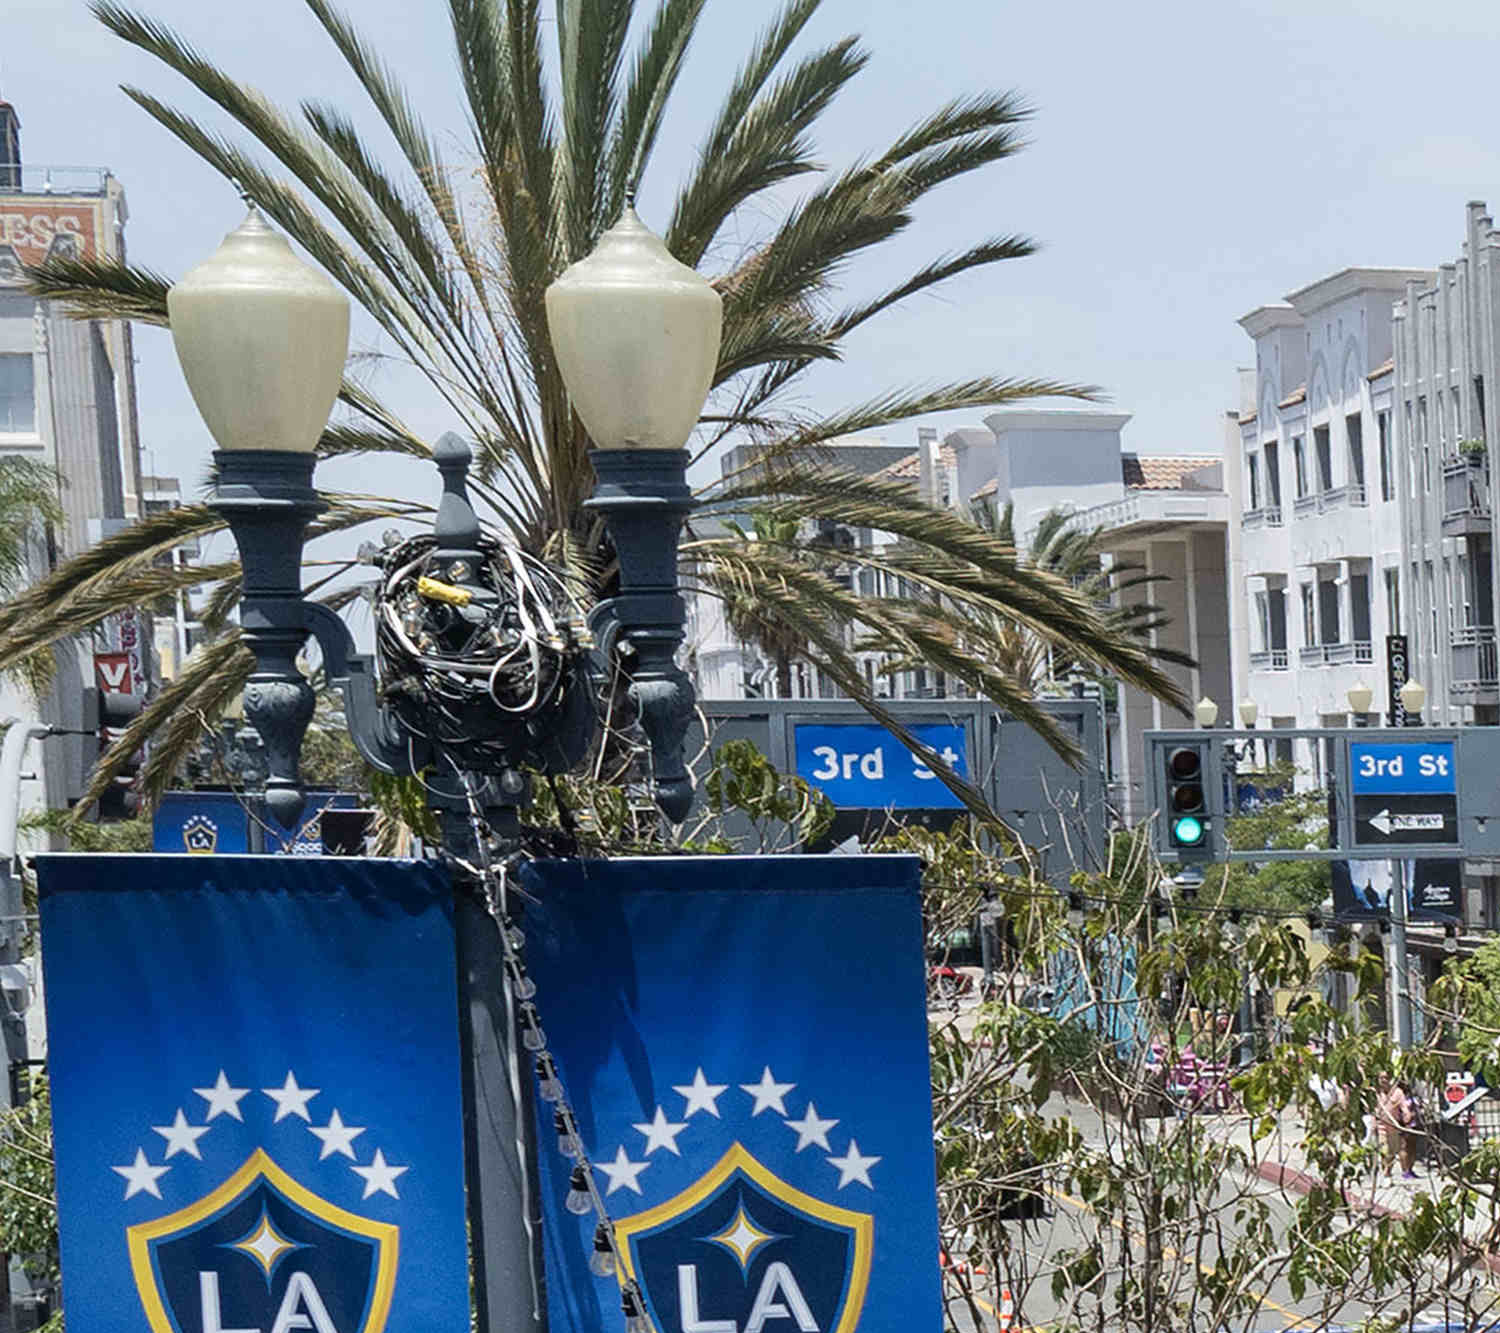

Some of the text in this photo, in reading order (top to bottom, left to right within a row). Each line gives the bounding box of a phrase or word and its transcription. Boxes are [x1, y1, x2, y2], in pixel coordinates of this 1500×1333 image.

[813, 746, 884, 780] 3rd
[1359, 753, 1448, 778] 3rd St
